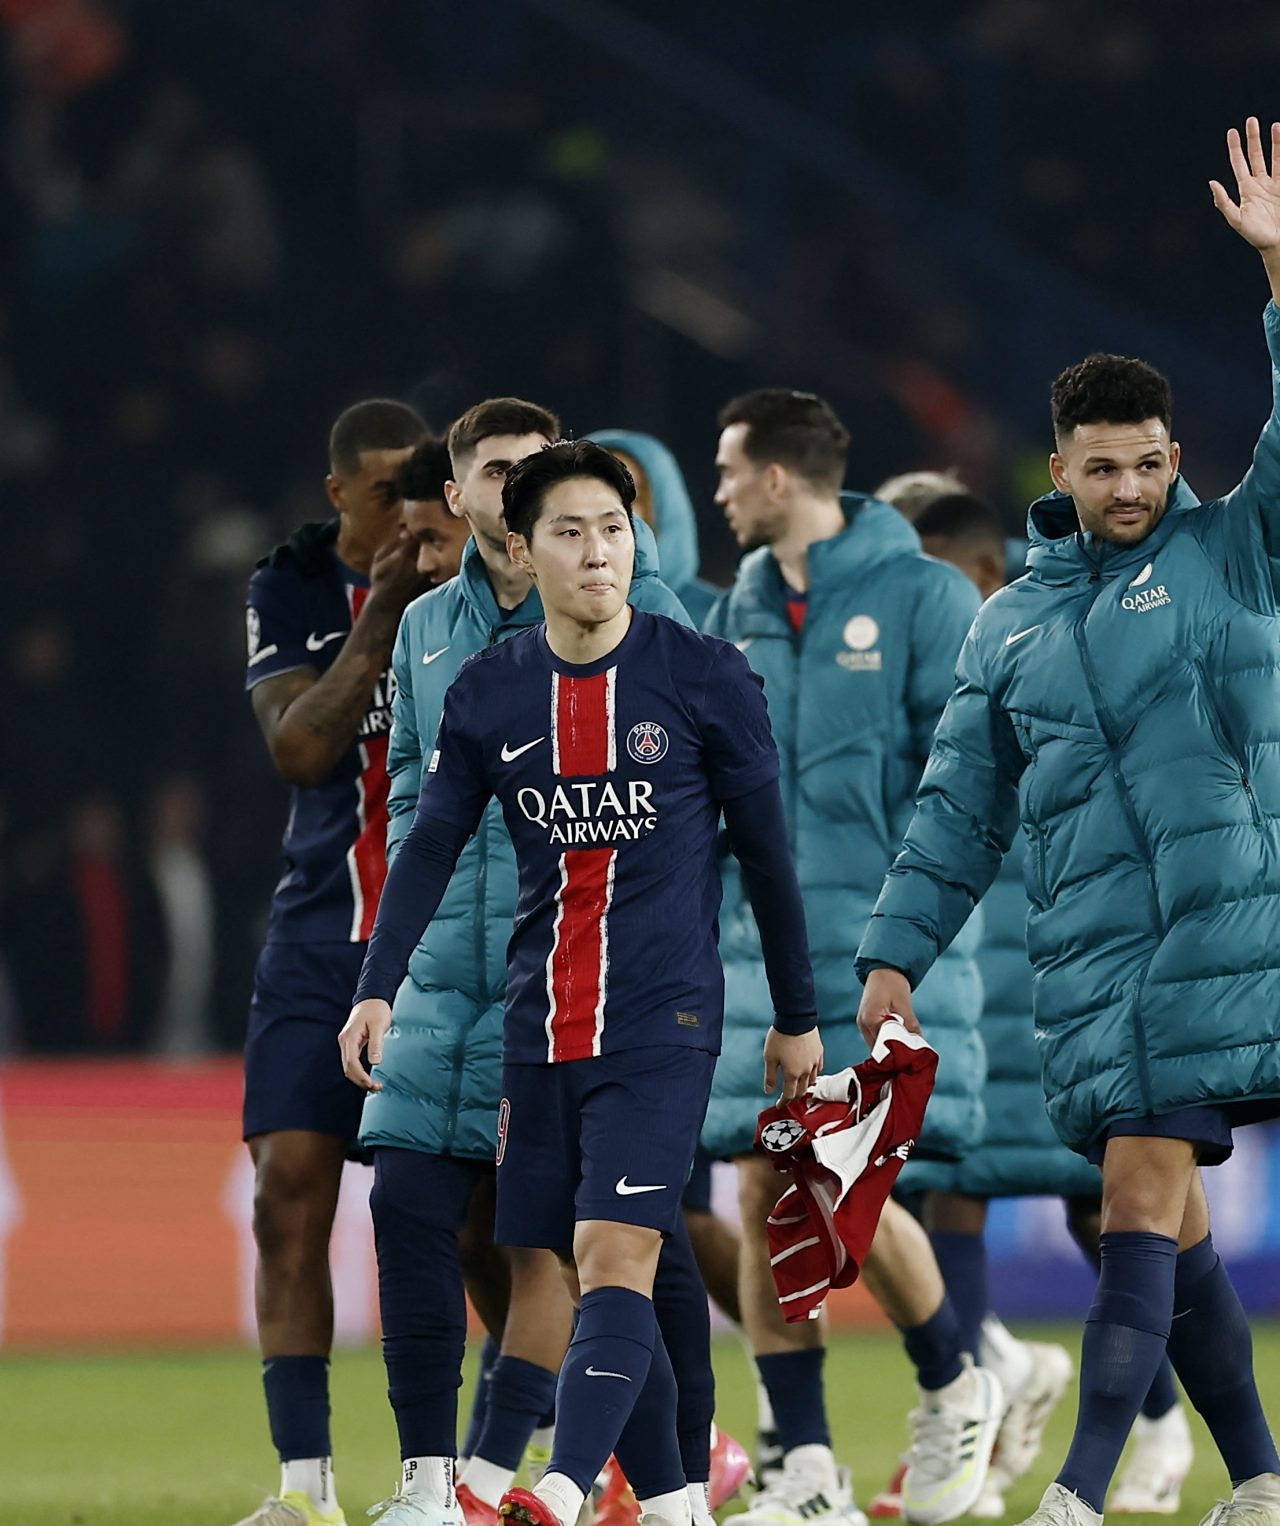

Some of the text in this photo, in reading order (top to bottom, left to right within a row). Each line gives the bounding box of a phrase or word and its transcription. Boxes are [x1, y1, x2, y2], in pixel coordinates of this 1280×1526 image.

[1121, 585, 1169, 610] QATAR
[1137, 596, 1172, 614] AIRWAYS
[633, 723, 661, 735] PARIS
[517, 780, 657, 829] QATAR
[549, 816, 658, 845] AIRWAYS
[496, 1097, 511, 1167] 9
